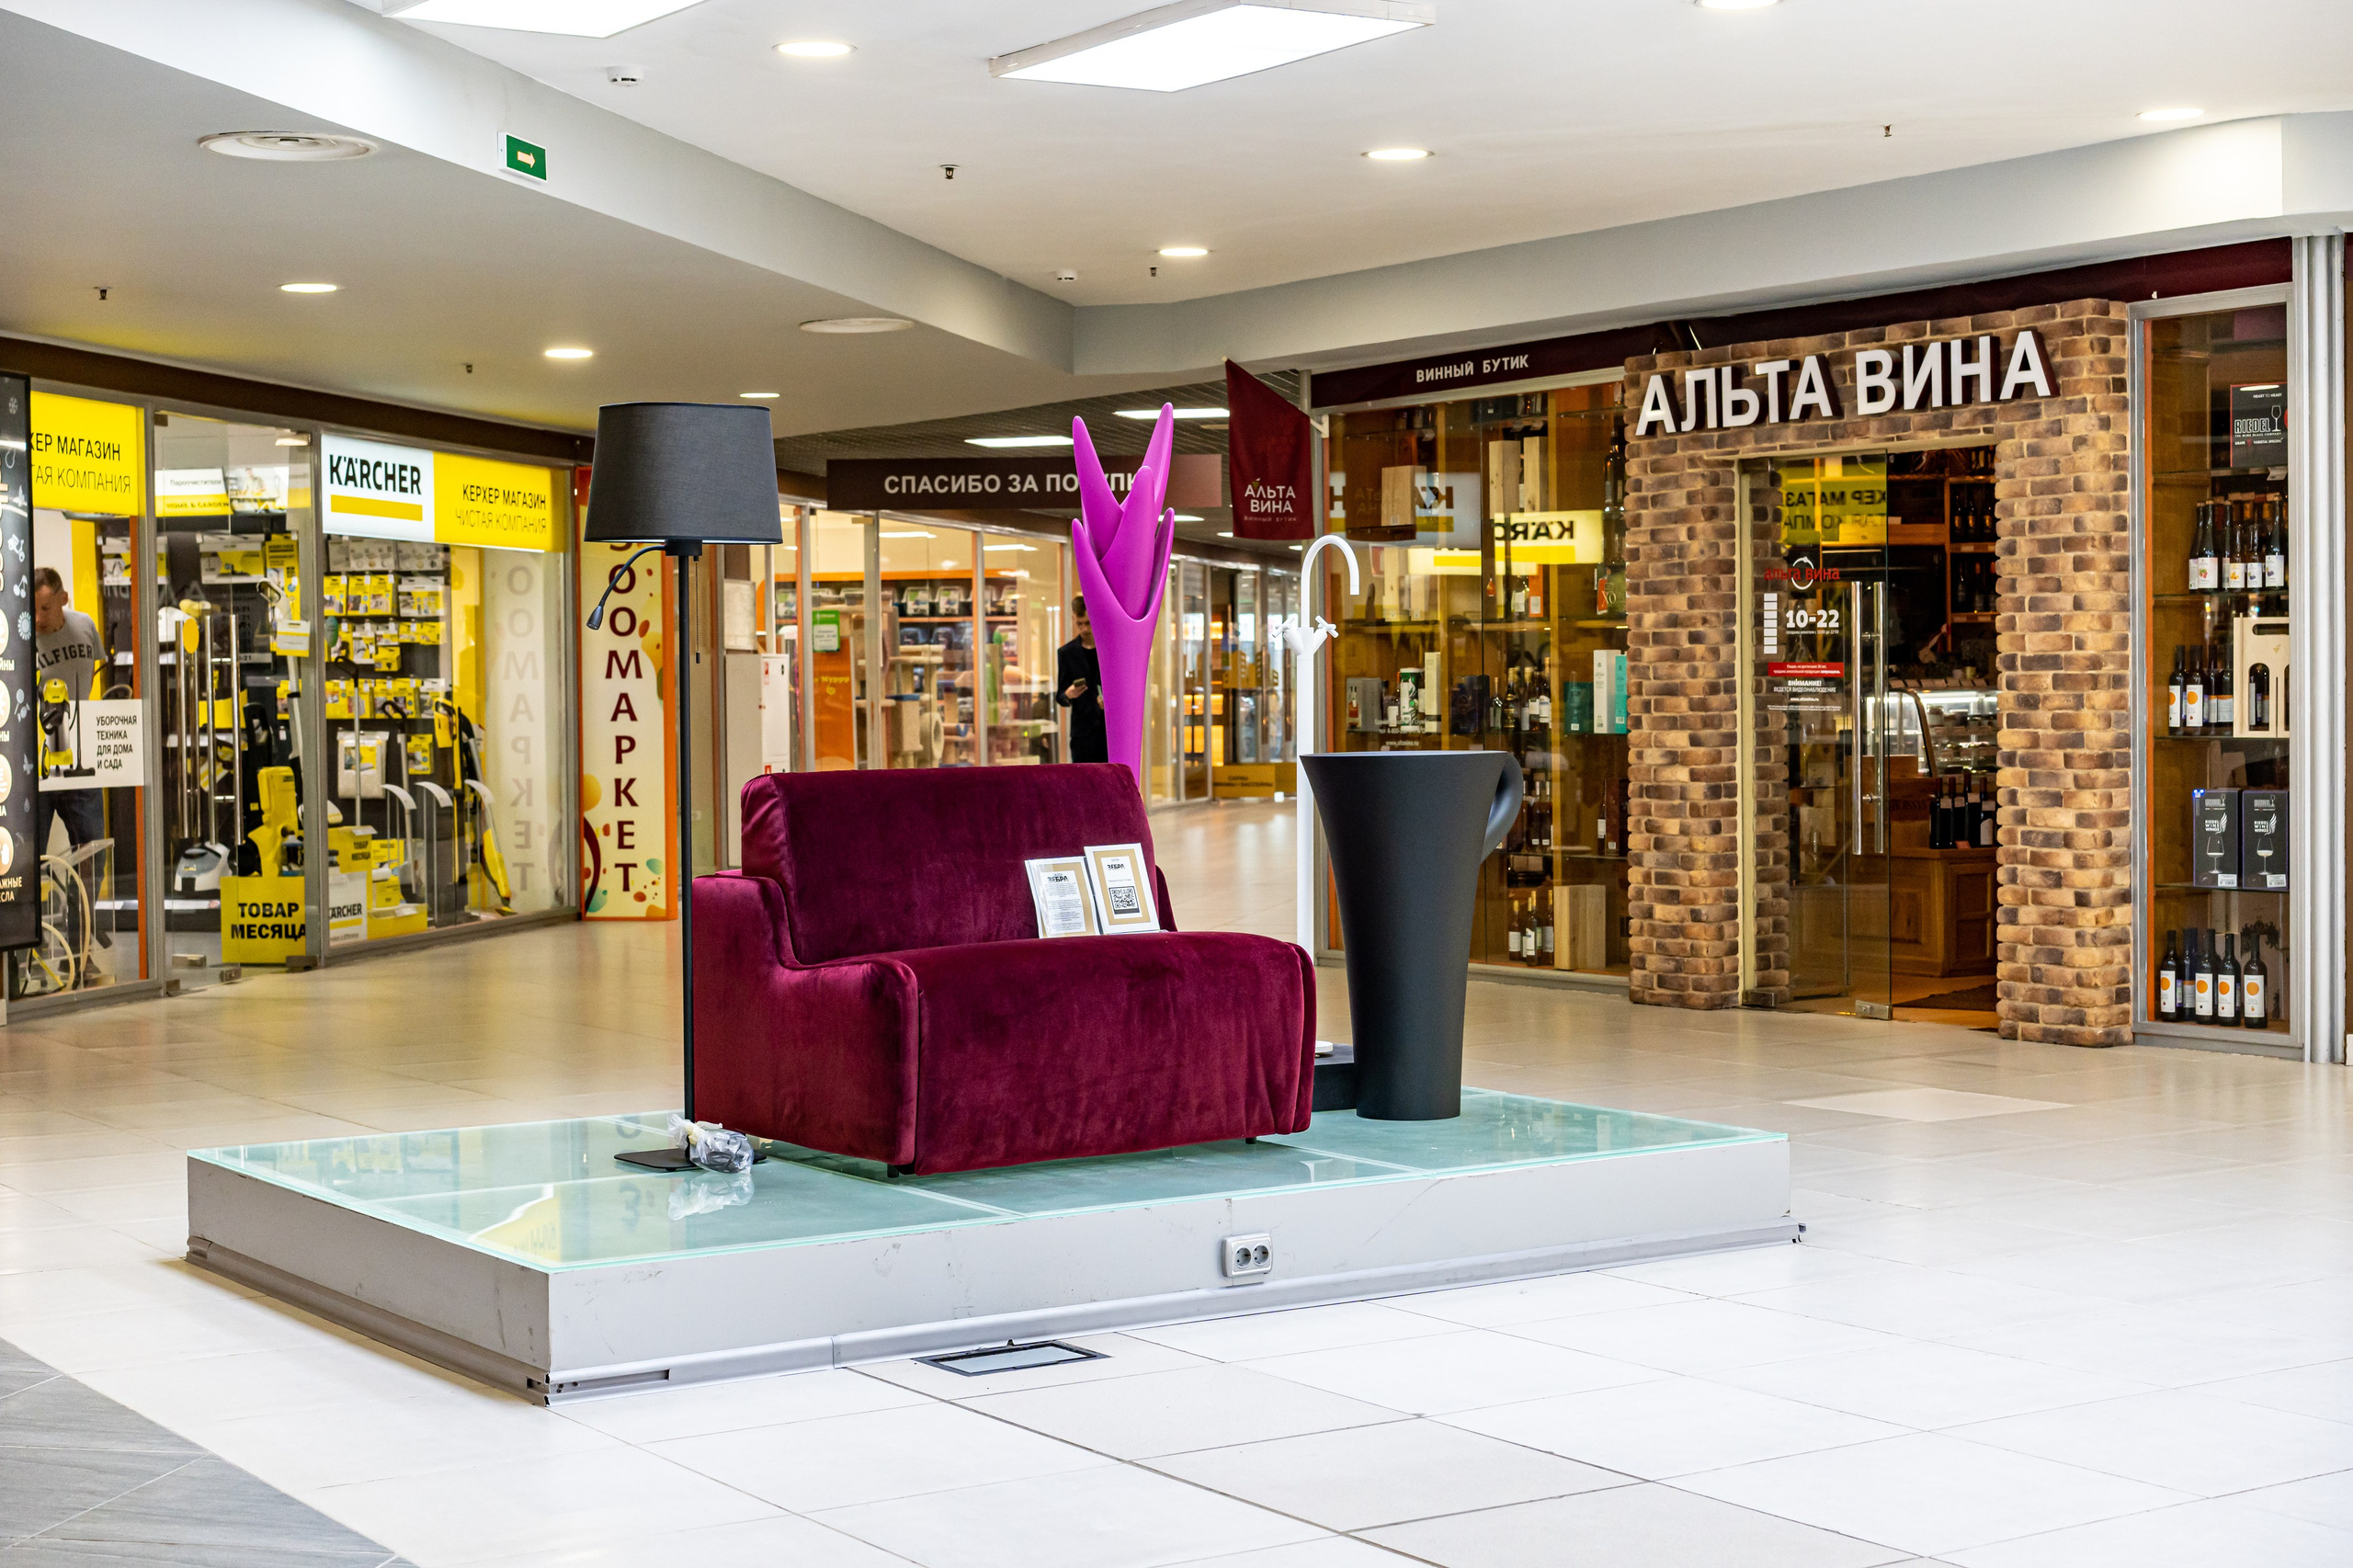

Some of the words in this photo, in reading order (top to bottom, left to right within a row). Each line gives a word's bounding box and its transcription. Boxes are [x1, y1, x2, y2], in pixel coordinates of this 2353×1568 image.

[1416, 362, 1474, 382] ВИННЫЙ
[1483, 355, 1529, 373] БУТИК
[1635, 355, 1834, 436] АЛЬТА
[1856, 330, 2052, 415] ВИНА
[2234, 418, 2271, 434] RIEDEL
[57, 435, 120, 461] МАГАЗИН
[58, 468, 131, 493] КОМПАНИЯ
[330, 454, 421, 495] KÄRCHER
[884, 475, 1001, 494] СПАСИБО
[1008, 474, 1039, 493] ЗА
[1046, 473, 1135, 493] ПОПК
[1244, 484, 1296, 498] АЛЬТА
[463, 484, 499, 504] КЕРХЕР
[502, 489, 546, 510] МАГАЗИН
[1250, 499, 1293, 513] ВИНА
[456, 508, 493, 528] ЧИСТАЯ
[496, 513, 546, 534] КОМПАНИЯ
[1805, 568, 1840, 580] вина
[1786, 609, 1839, 628] 10-22
[38, 644, 92, 669] ILFIGER
[97, 715, 137, 726] УБОРОЧНАЯ
[97, 730, 127, 741] ТЕХНИКА
[97, 745, 111, 756] ДЛЯ
[113, 744, 133, 755] ДОМА
[97, 759, 102, 769] И
[104, 758, 123, 770] САДА
[0, 891, 15, 902] СЛА
[238, 903, 299, 918] ТОВАР
[231, 924, 306, 941] МЕСЯЦА
